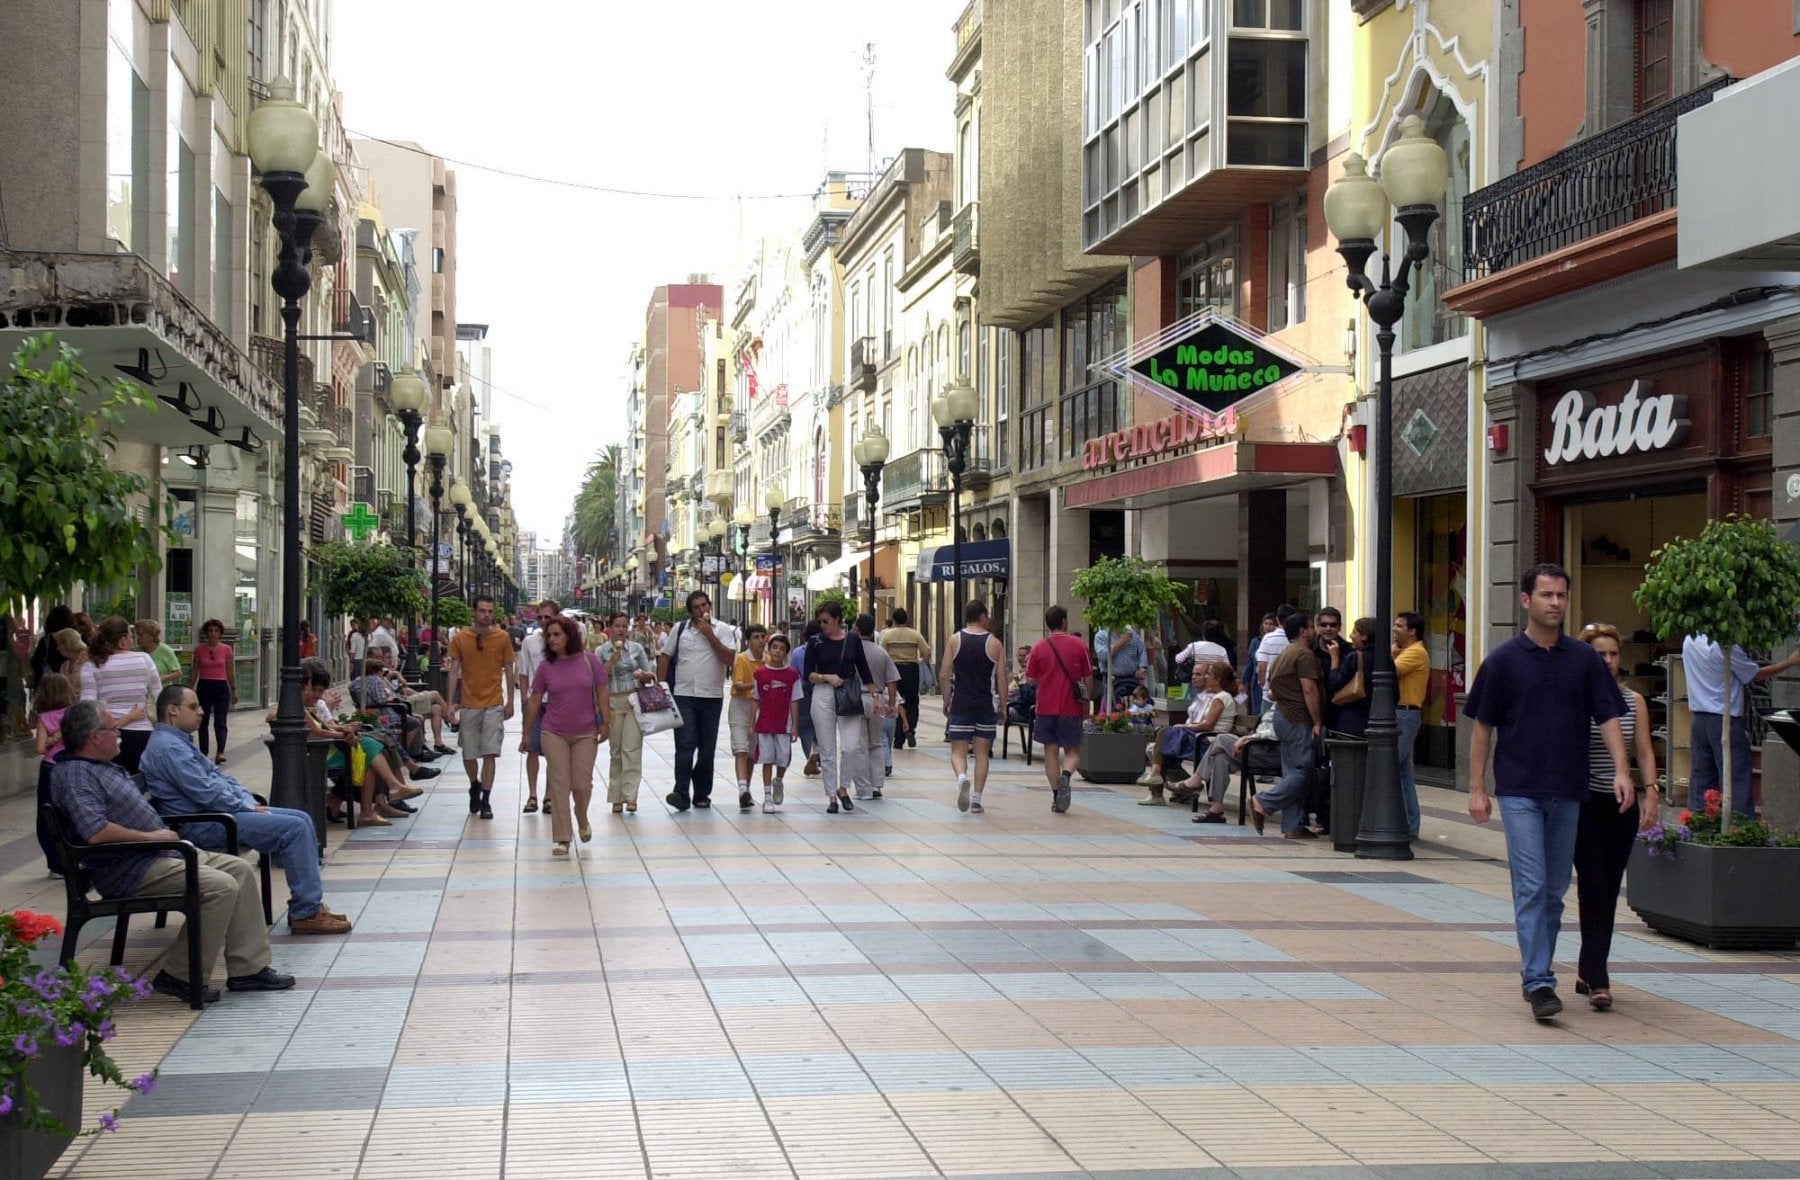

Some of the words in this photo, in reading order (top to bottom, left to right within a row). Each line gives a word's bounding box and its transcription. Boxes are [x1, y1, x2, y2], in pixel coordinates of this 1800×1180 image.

[1151, 357, 1178, 388] La
[1186, 364, 1280, 392] Muñeca
[1177, 345, 1254, 365] Modas
[1083, 405, 1239, 470] arencibia
[1544, 379, 1678, 466] Bata
